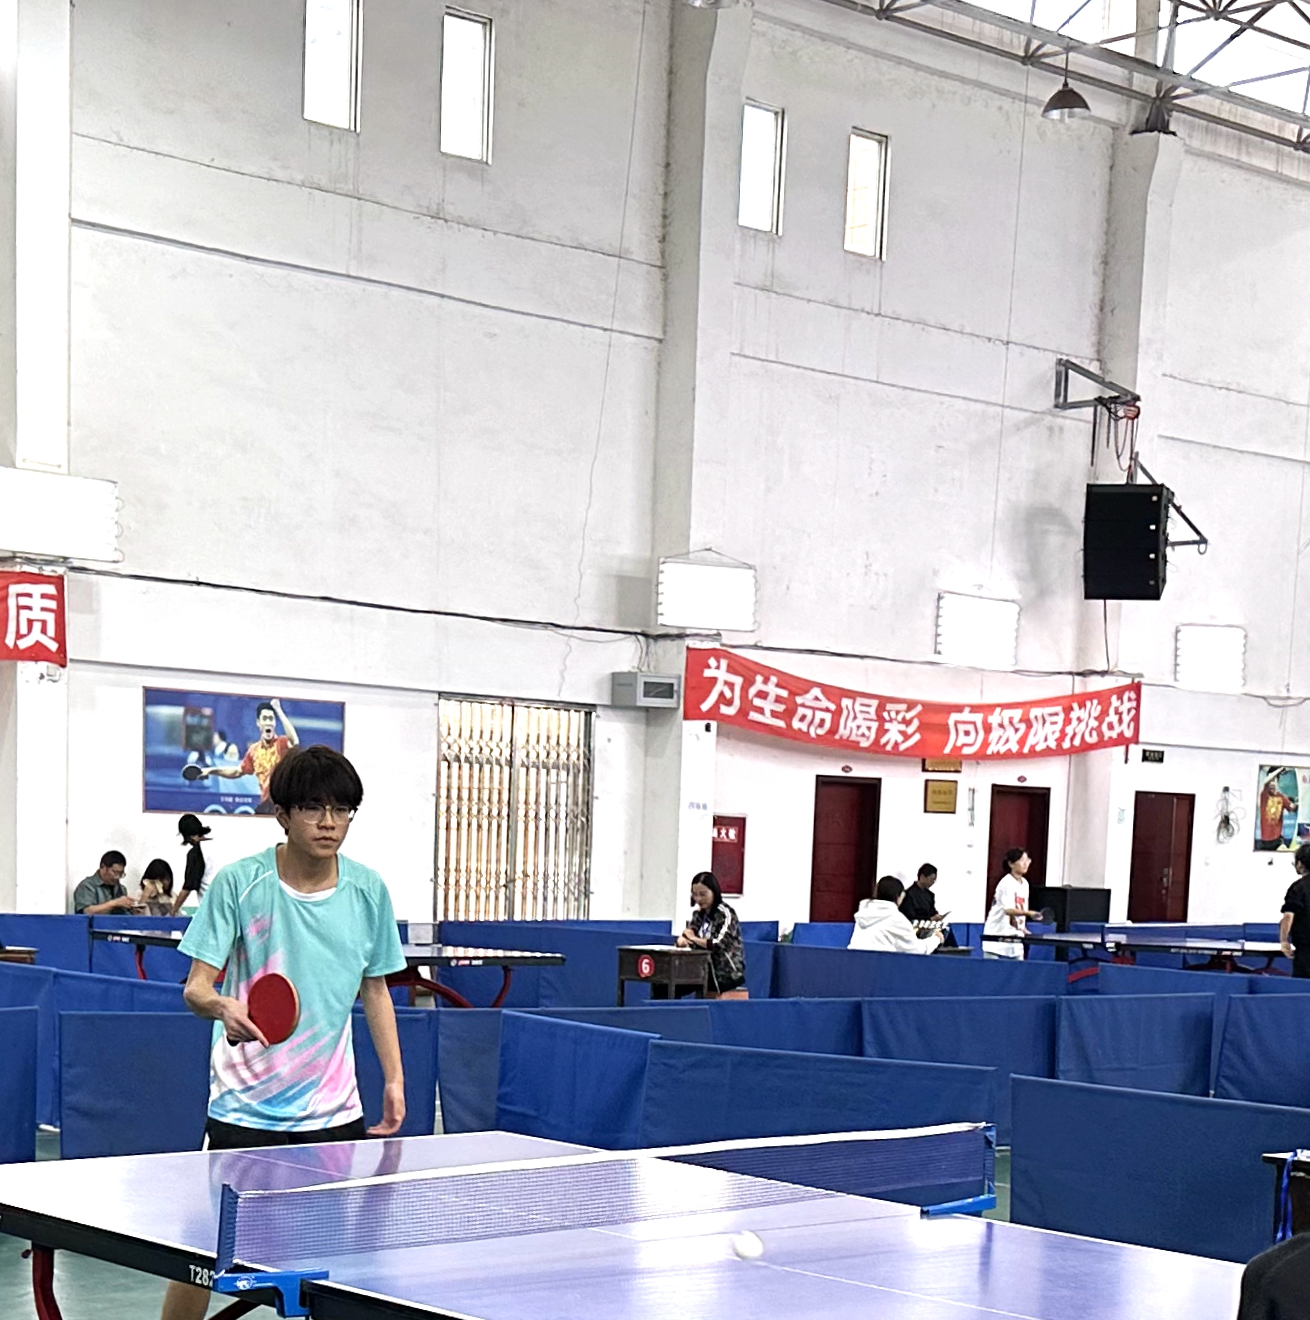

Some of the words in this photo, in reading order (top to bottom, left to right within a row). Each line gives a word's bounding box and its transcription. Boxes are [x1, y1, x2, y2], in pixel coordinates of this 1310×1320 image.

[699, 657, 922, 752] 为生命喝彩
[943, 690, 1137, 755] 向极限挑战
[641, 959, 650, 973] 6
